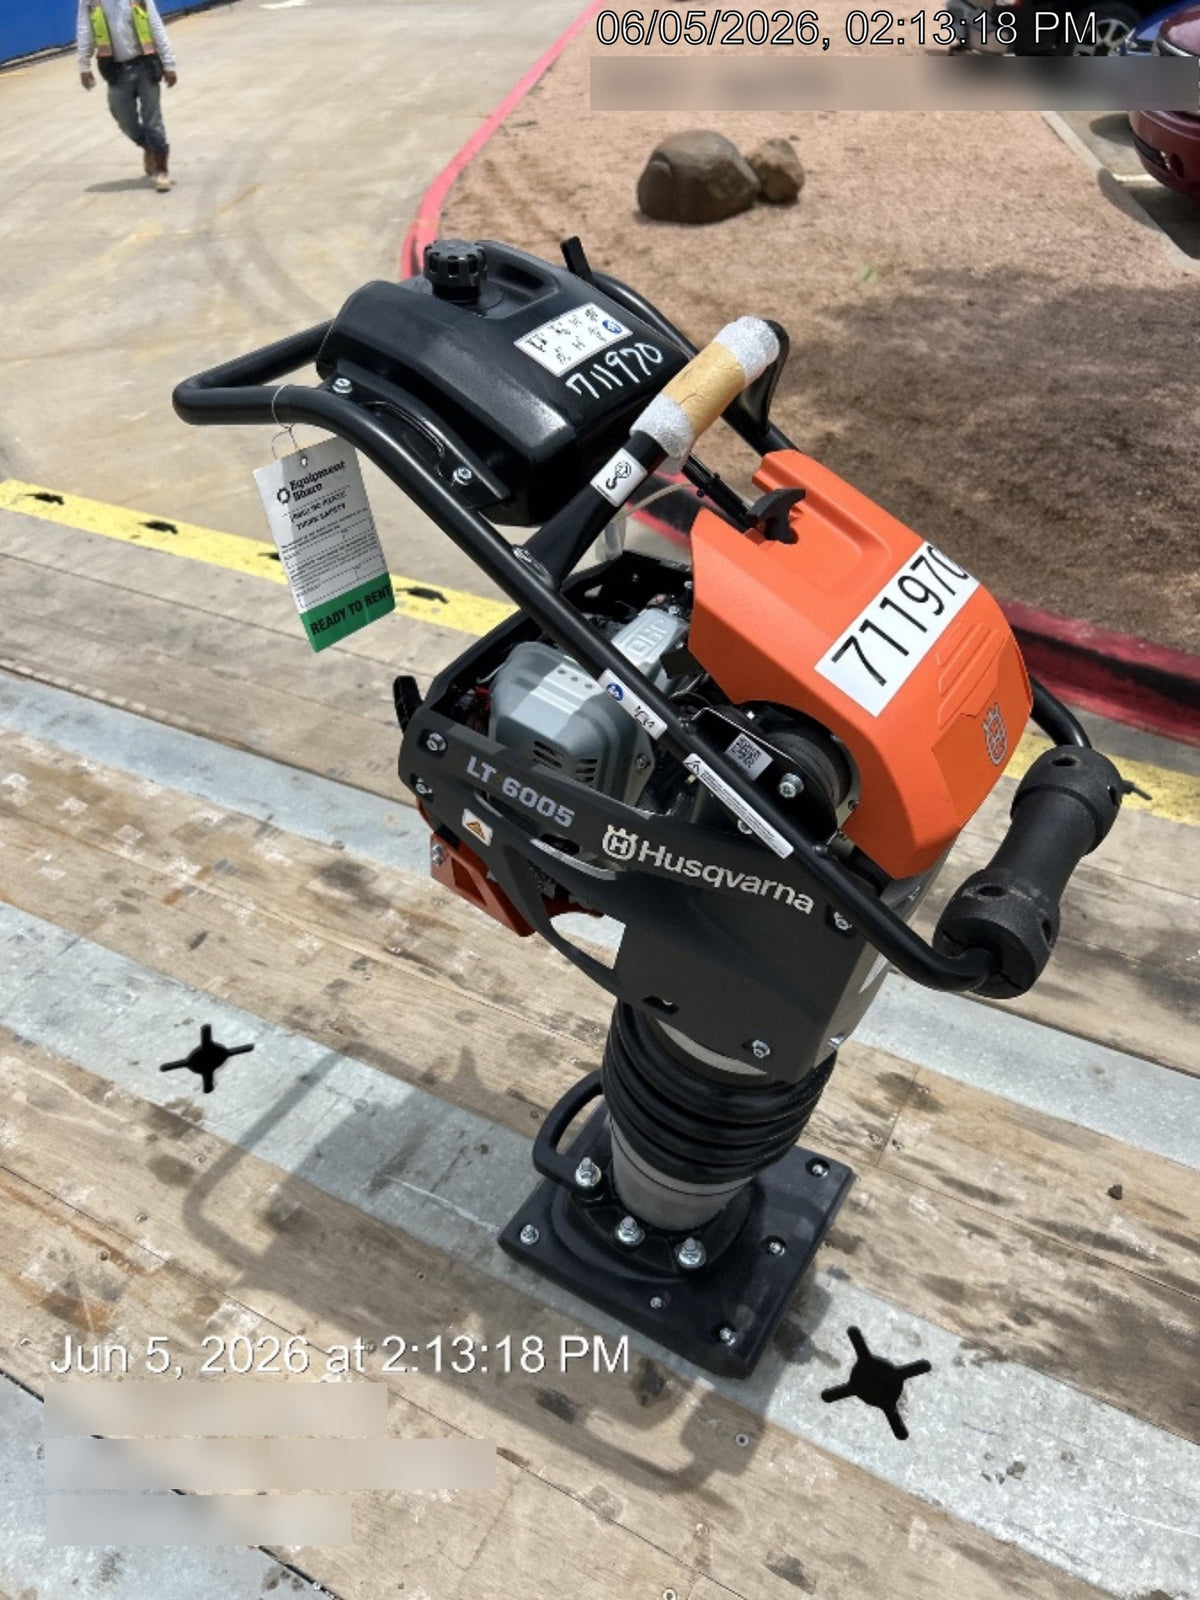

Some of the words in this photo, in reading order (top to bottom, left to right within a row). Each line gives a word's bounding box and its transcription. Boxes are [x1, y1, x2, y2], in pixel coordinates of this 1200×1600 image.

[565, 342, 664, 399] 711970
[310, 607, 347, 635] READY
[349, 600, 364, 617] TO
[364, 584, 392, 606] RENT
[466, 756, 497, 784] LT
[502, 778, 575, 828] 6005
[637, 840, 815, 915] Husqvarna
